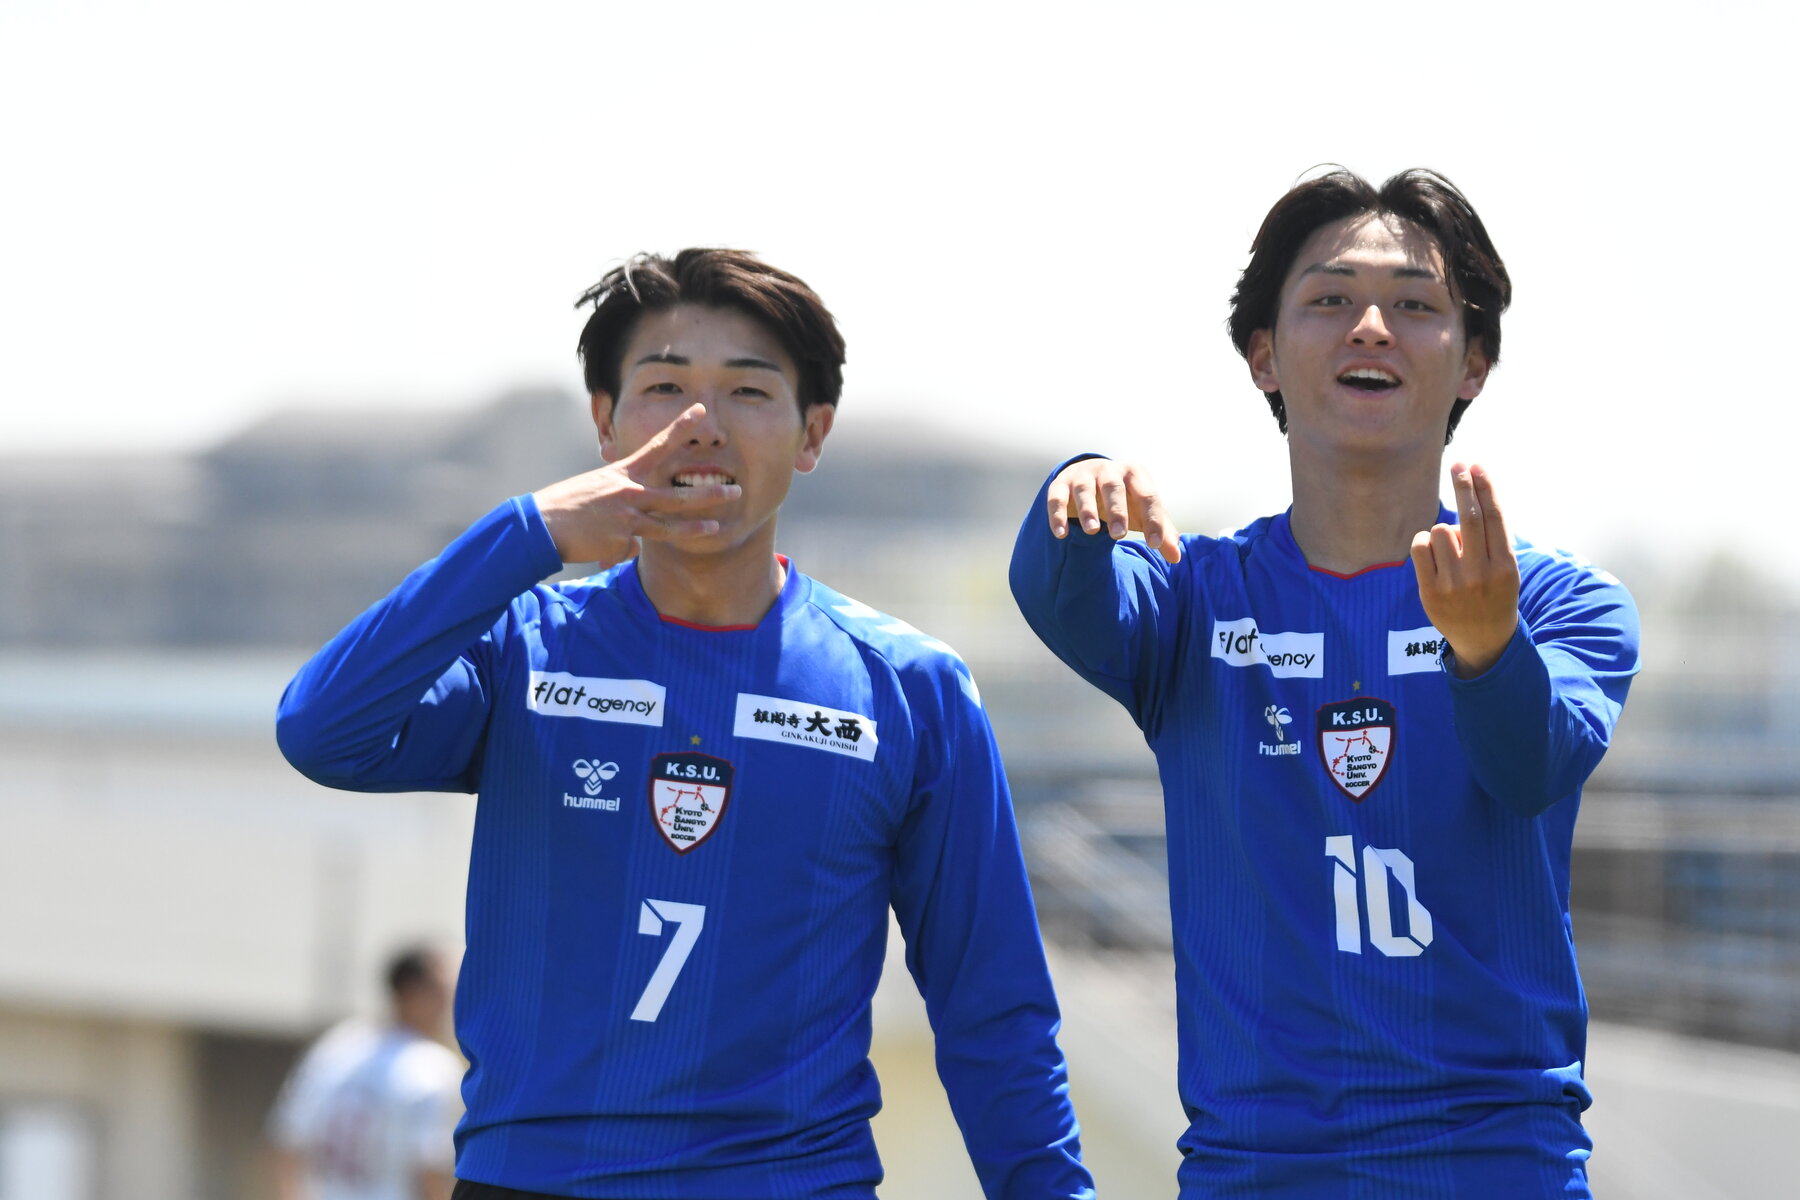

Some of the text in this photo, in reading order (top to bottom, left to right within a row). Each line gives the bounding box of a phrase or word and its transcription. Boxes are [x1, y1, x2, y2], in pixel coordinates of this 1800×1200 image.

[534, 681, 656, 716] flat agency
[1332, 708, 1384, 726] K.S.U.
[781, 730, 858, 752] GINKAKUJI ONISHI
[666, 762, 721, 781] K.S.U.
[563, 792, 621, 812] hummel
[1325, 834, 1434, 957] 10
[629, 897, 707, 1023] 7
